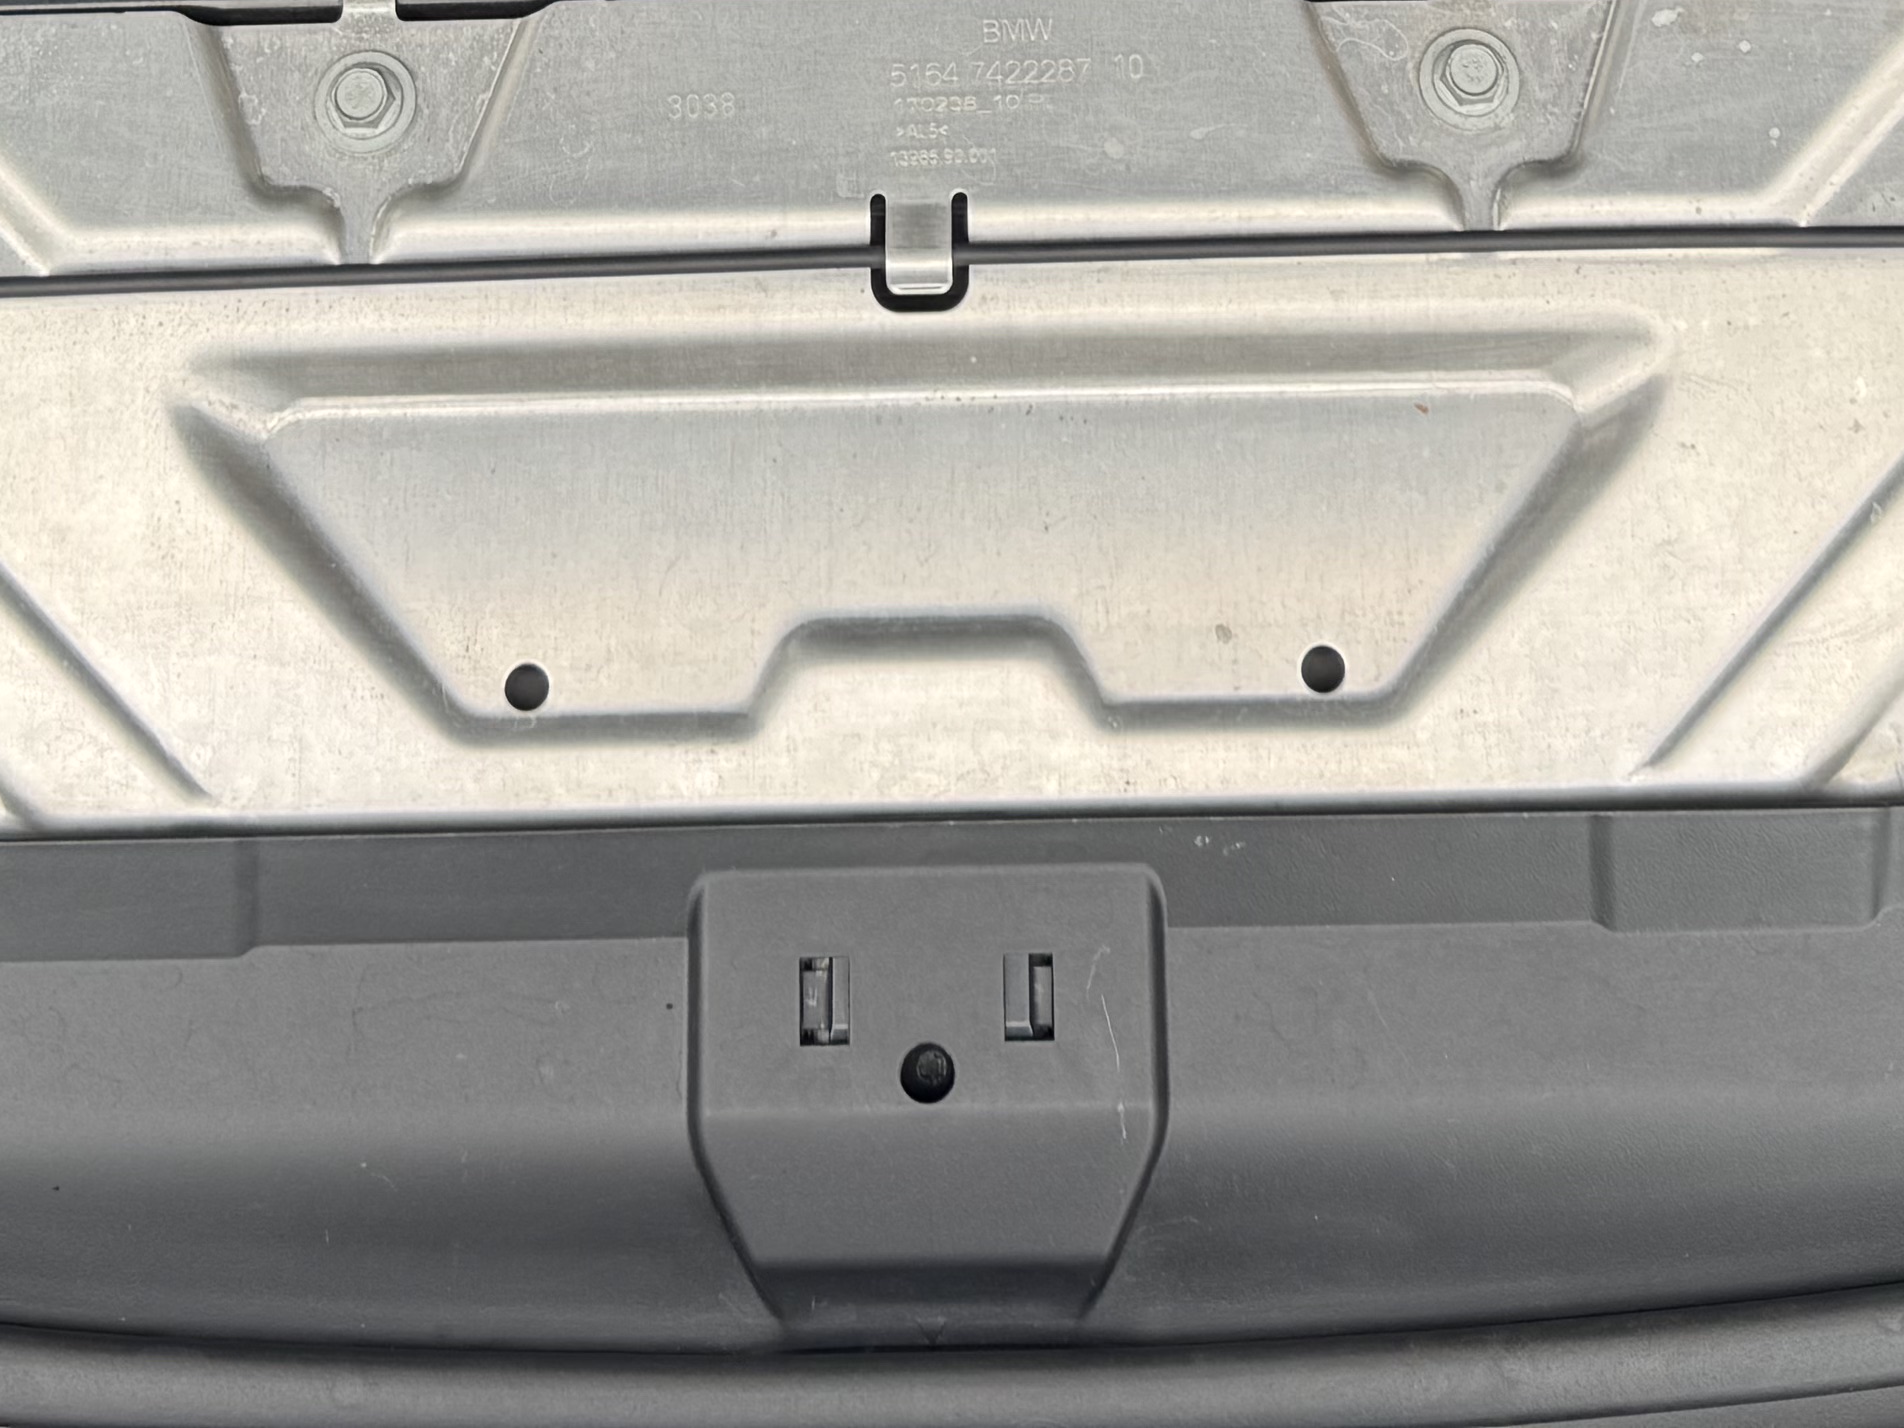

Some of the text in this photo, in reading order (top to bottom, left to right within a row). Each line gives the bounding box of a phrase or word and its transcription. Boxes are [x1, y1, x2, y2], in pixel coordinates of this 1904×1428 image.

[982, 18, 1054, 44] BMW
[889, 53, 1145, 88] 5164 7422287 10
[666, 91, 736, 120] 3038
